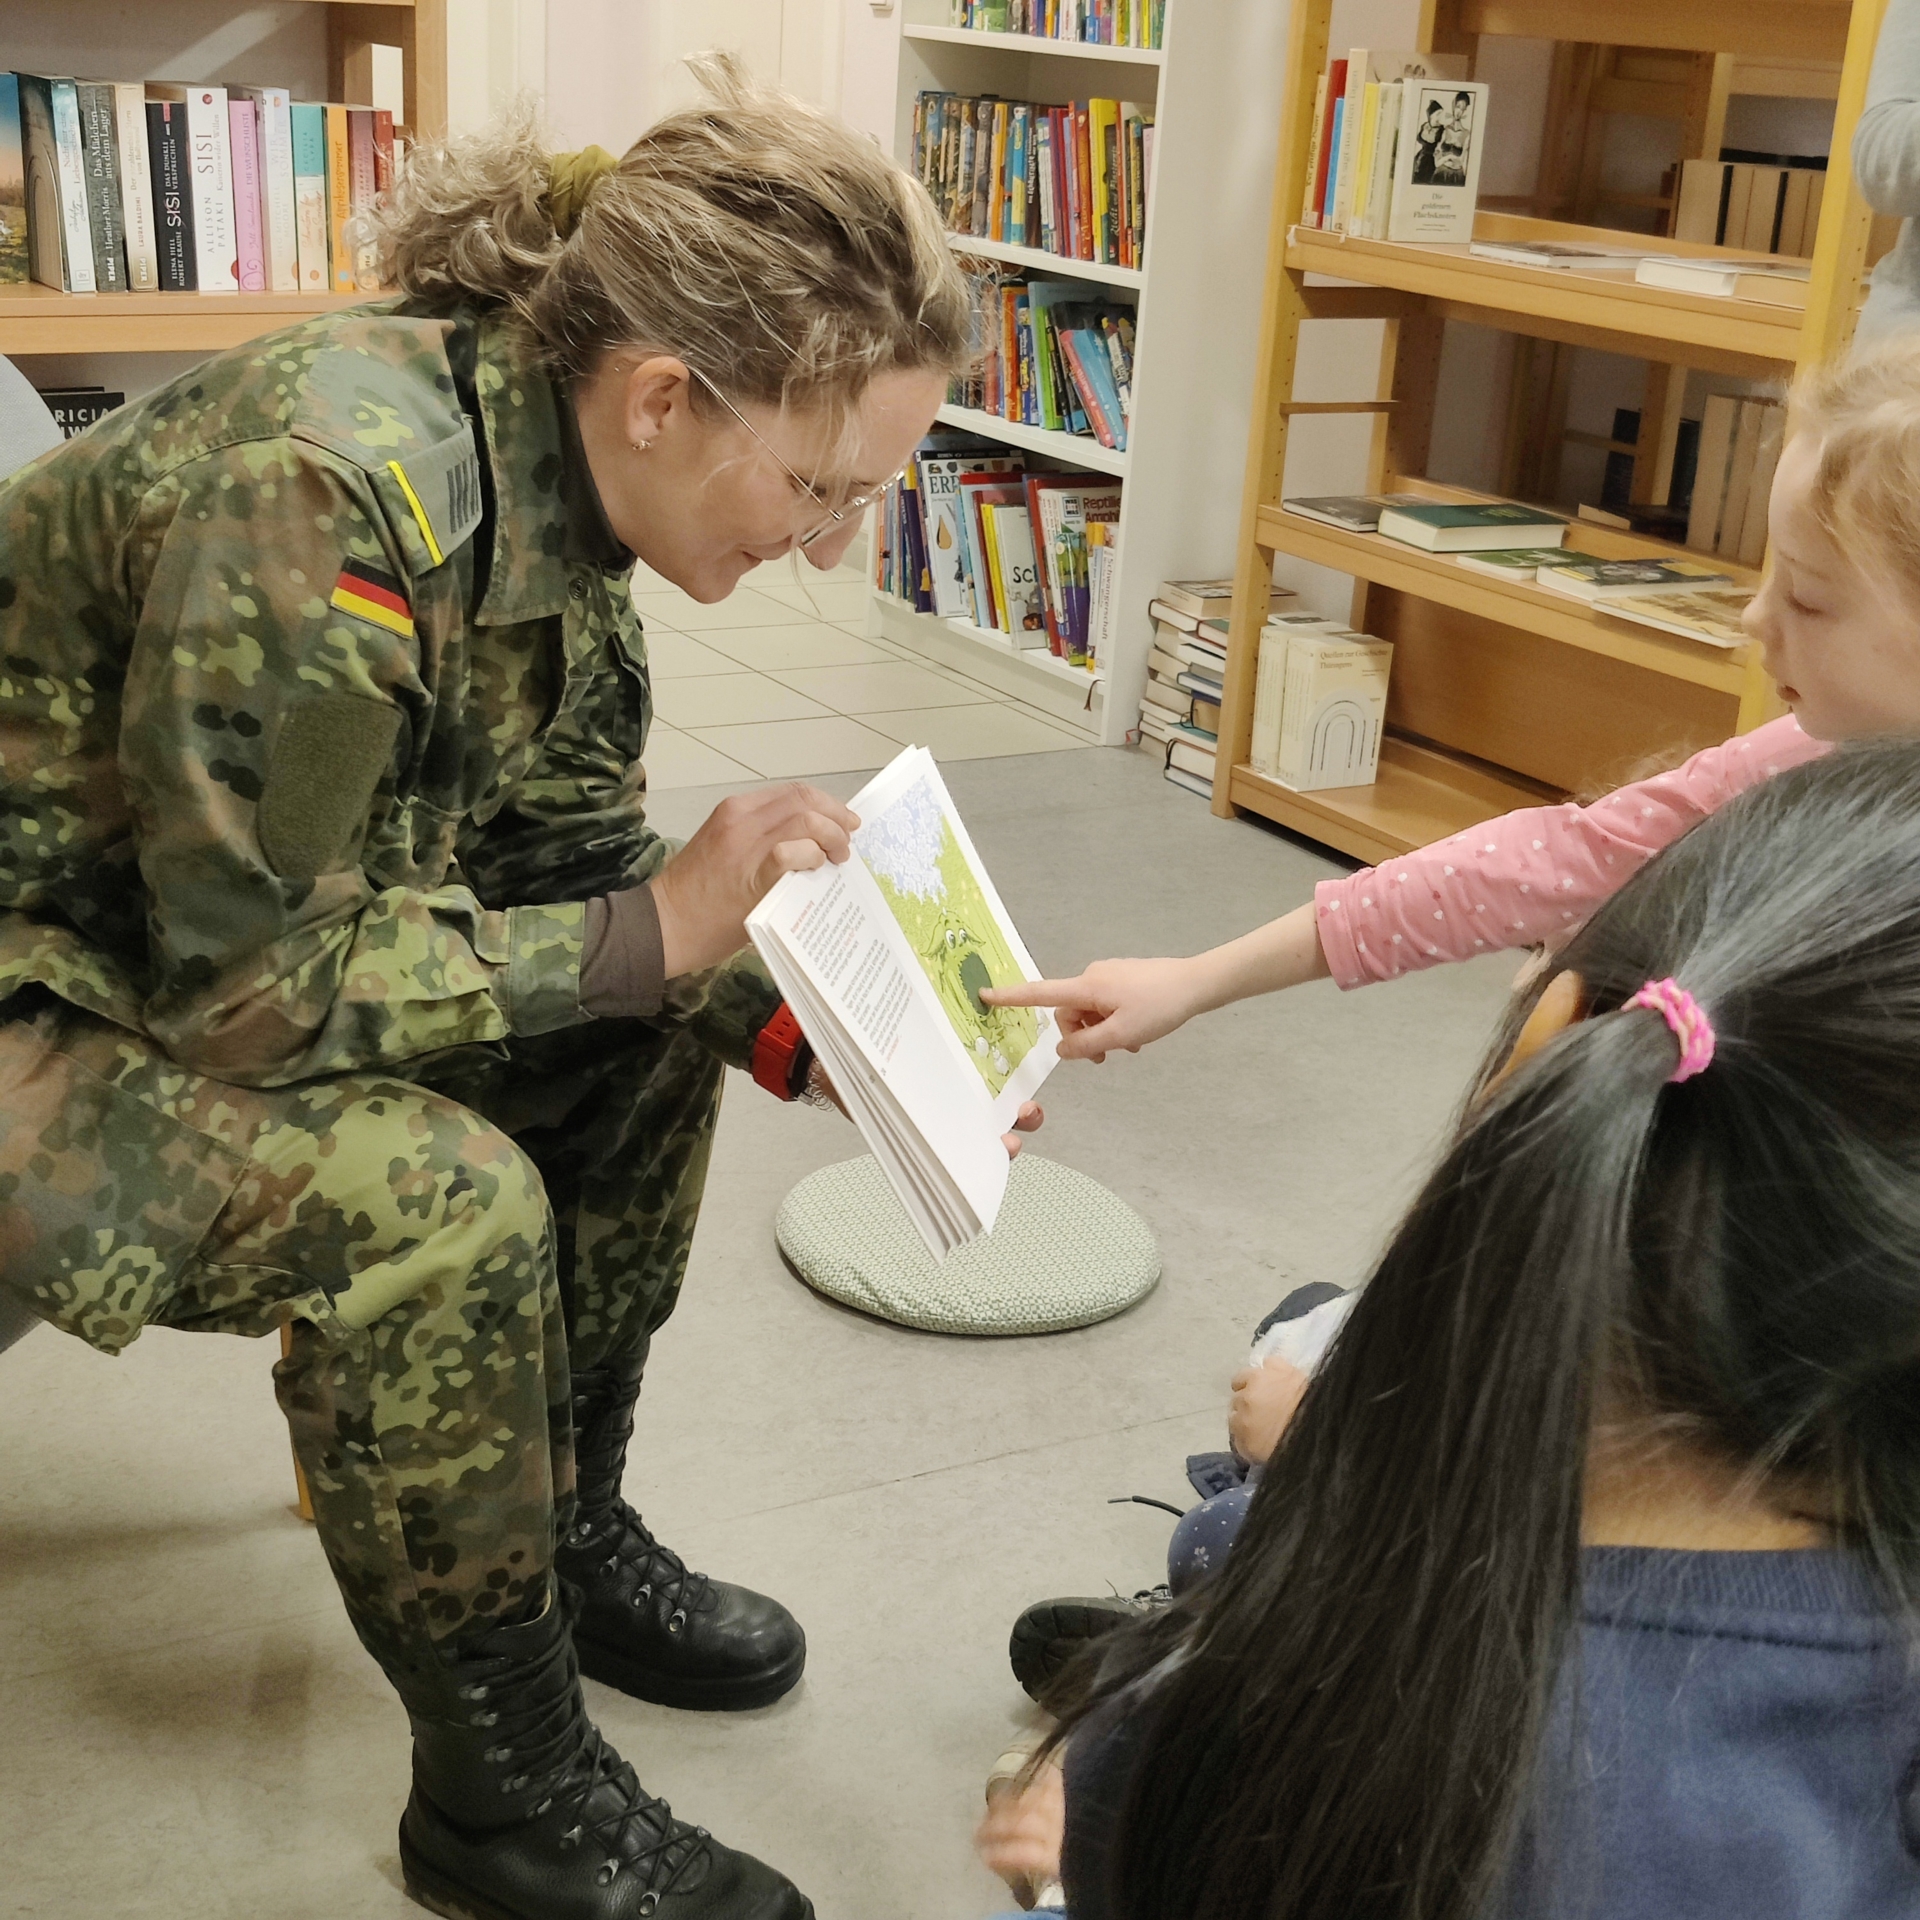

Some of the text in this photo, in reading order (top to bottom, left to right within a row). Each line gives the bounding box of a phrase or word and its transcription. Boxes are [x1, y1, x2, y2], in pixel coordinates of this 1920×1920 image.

[90, 111, 103, 177] Das Mädchen
[100, 109, 112, 179] aus dem Lager
[162, 141, 170, 171] DUNKLE
[169, 139, 178, 190] VERSPRECHEN
[196, 134, 214, 174] SISI
[212, 114, 224, 191] Kaiserin wider Willen
[277, 120, 289, 177] SOMMER
[164, 173, 172, 187] DAS
[246, 172, 254, 186] DIE
[101, 187, 114, 249] Heather Morris
[164, 192, 182, 227] SISI
[204, 196, 215, 254] ALLISON
[215, 201, 225, 247] PATAKI
[175, 231, 183, 257] KRAUSE
[107, 257, 116, 282] PIPER
[139, 257, 148, 282] PIPER
[1102, 558, 1114, 640] Schwangerschaft
